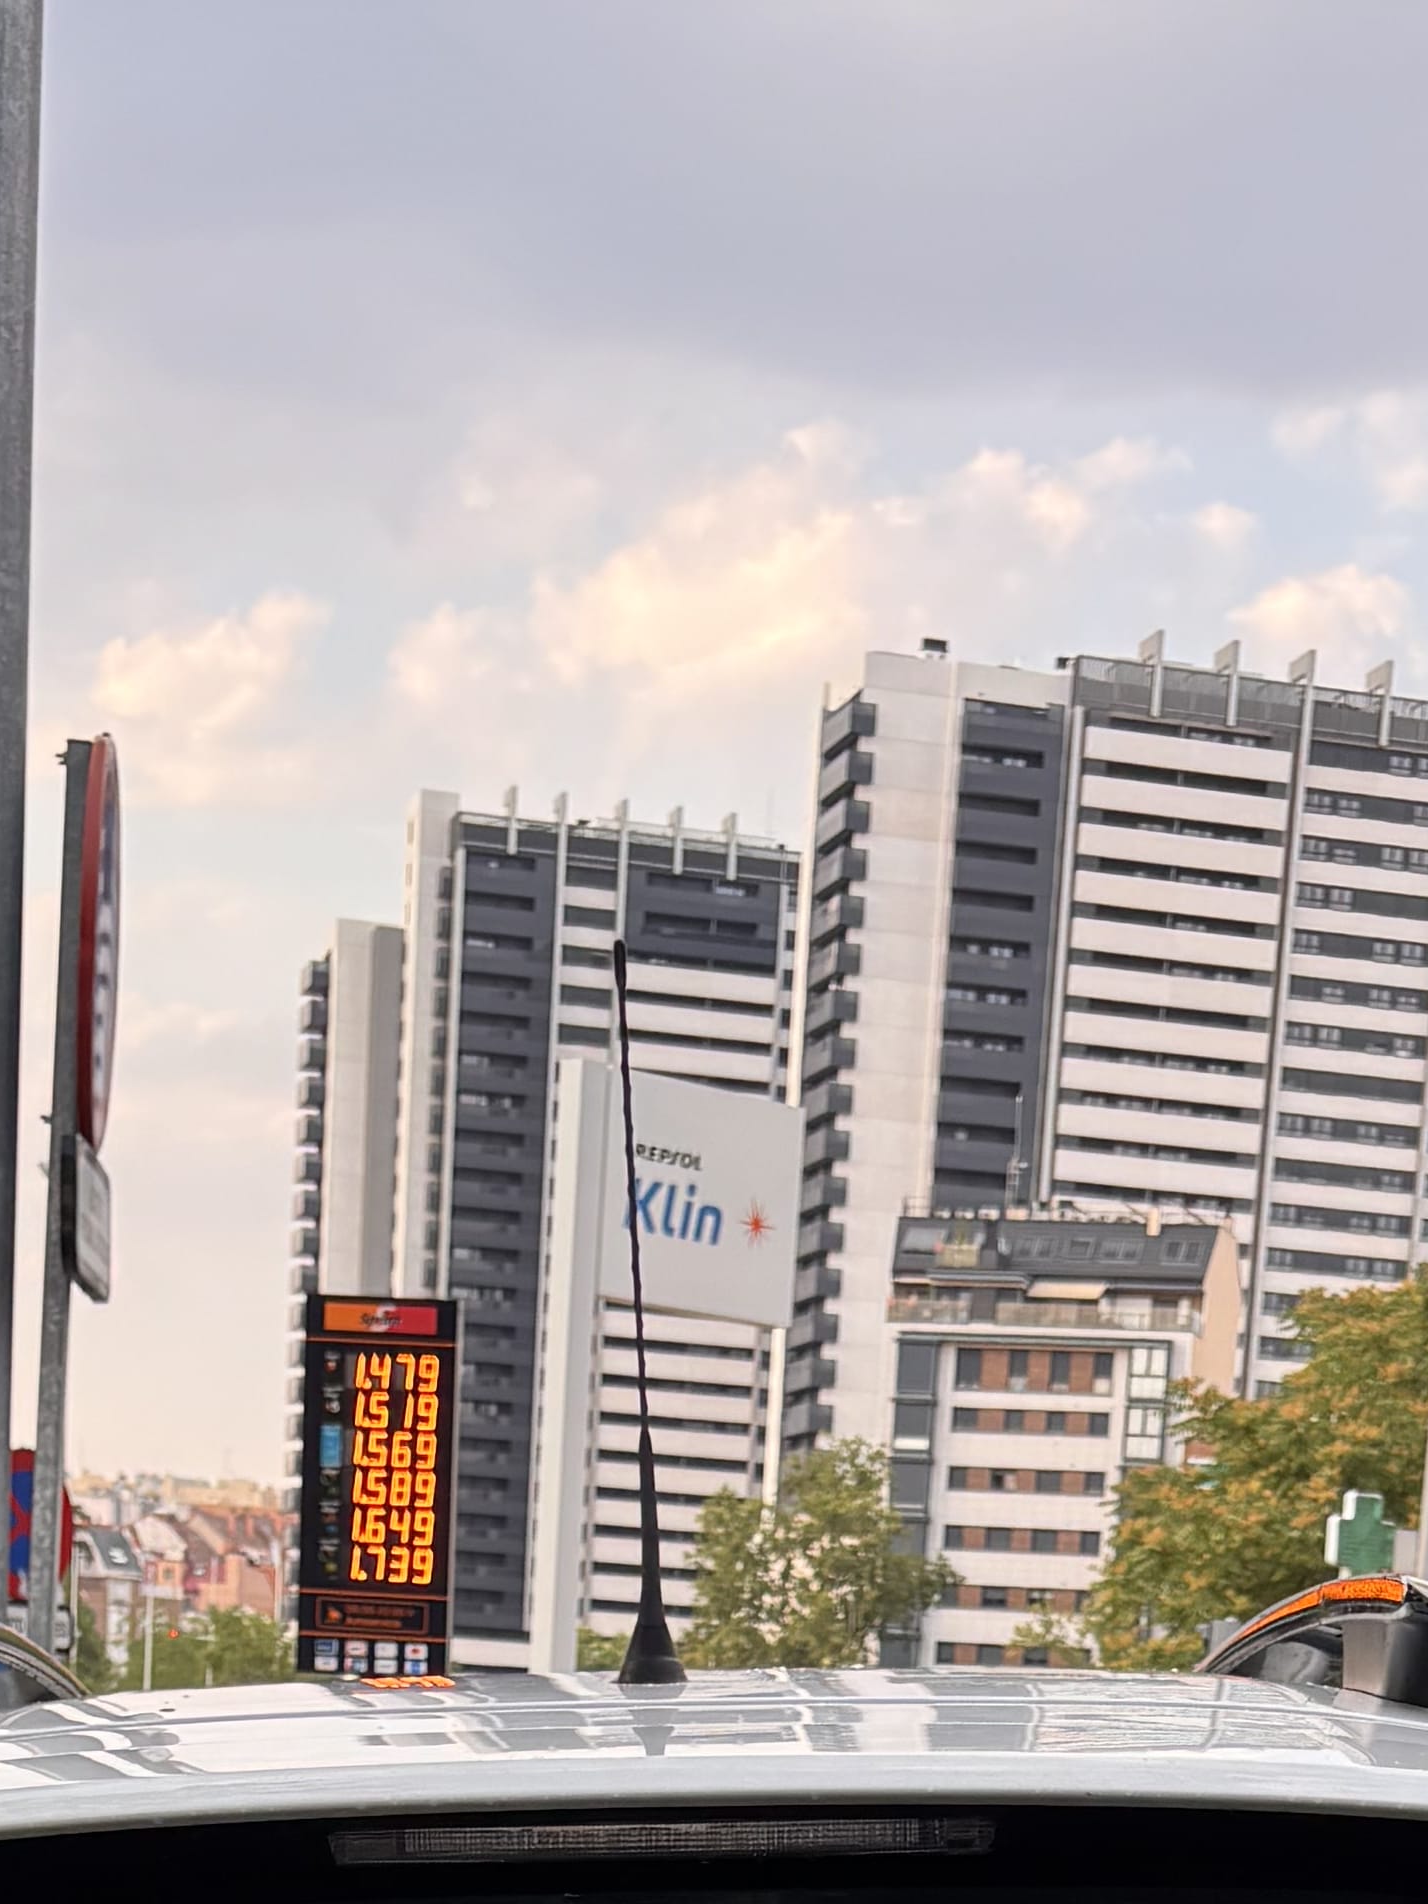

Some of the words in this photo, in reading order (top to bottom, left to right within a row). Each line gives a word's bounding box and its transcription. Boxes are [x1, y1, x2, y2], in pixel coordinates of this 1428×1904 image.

[624, 1177, 723, 1246] Klin
[356, 1352, 440, 1393] 1.479
[354, 1391, 439, 1431] 1.519
[353, 1430, 438, 1470] 1.569
[352, 1467, 437, 1508] 1.589
[351, 1507, 435, 1546] 1.649
[350, 1545, 434, 1585] 1.739
